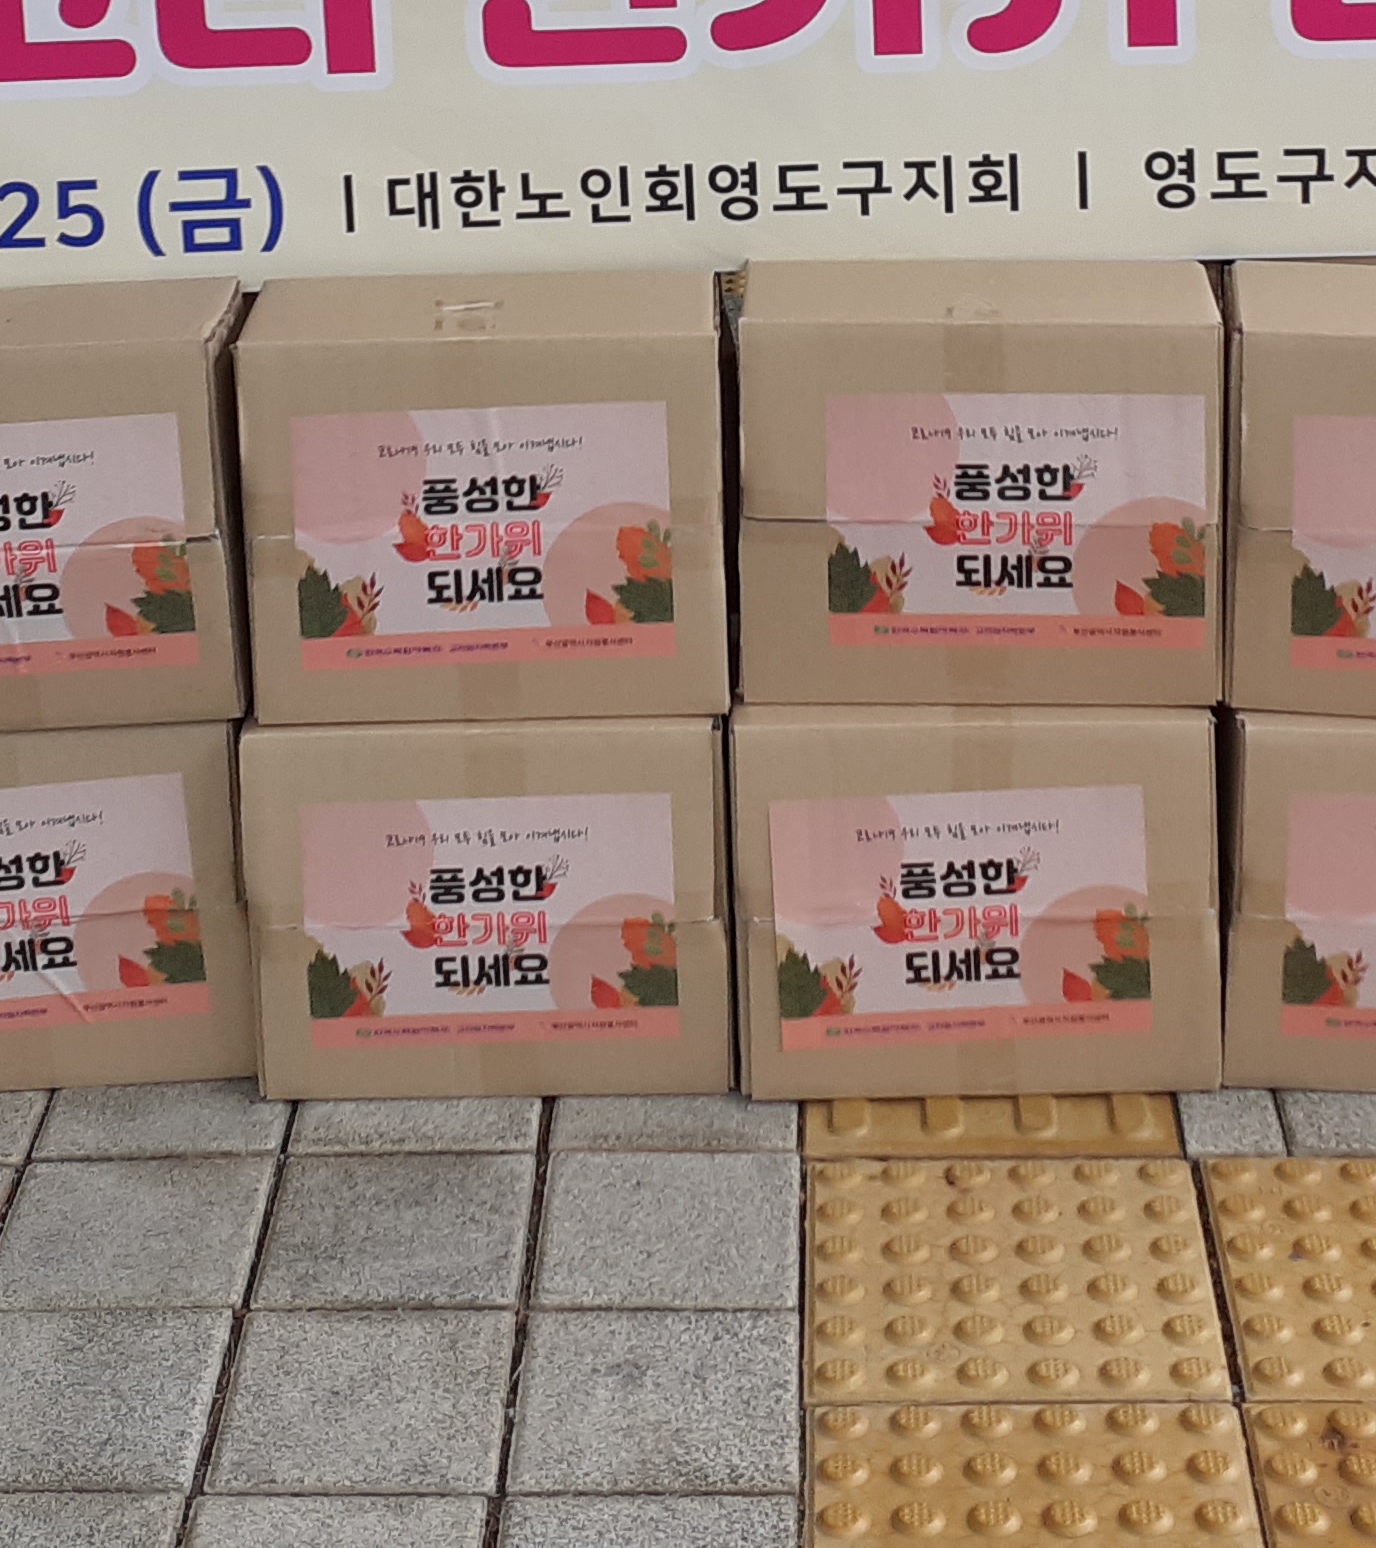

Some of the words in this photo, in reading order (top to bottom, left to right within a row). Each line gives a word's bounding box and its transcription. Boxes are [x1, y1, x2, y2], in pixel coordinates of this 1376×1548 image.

[386, 151, 1021, 231] 대한노인회영도구지회
[423, 475, 542, 516] 풍성한
[955, 463, 1074, 502] 풍성한
[424, 520, 542, 561] 한가위
[955, 510, 1073, 547] 한가위
[427, 564, 544, 606] 되세요
[956, 554, 1073, 589] 되세요
[429, 865, 549, 905] 풍성한
[900, 858, 1019, 900] 풍성한
[433, 911, 548, 947] 한가위
[904, 903, 1019, 943] 한가위
[435, 953, 550, 989] 되세요
[906, 946, 1021, 986] 되세요
